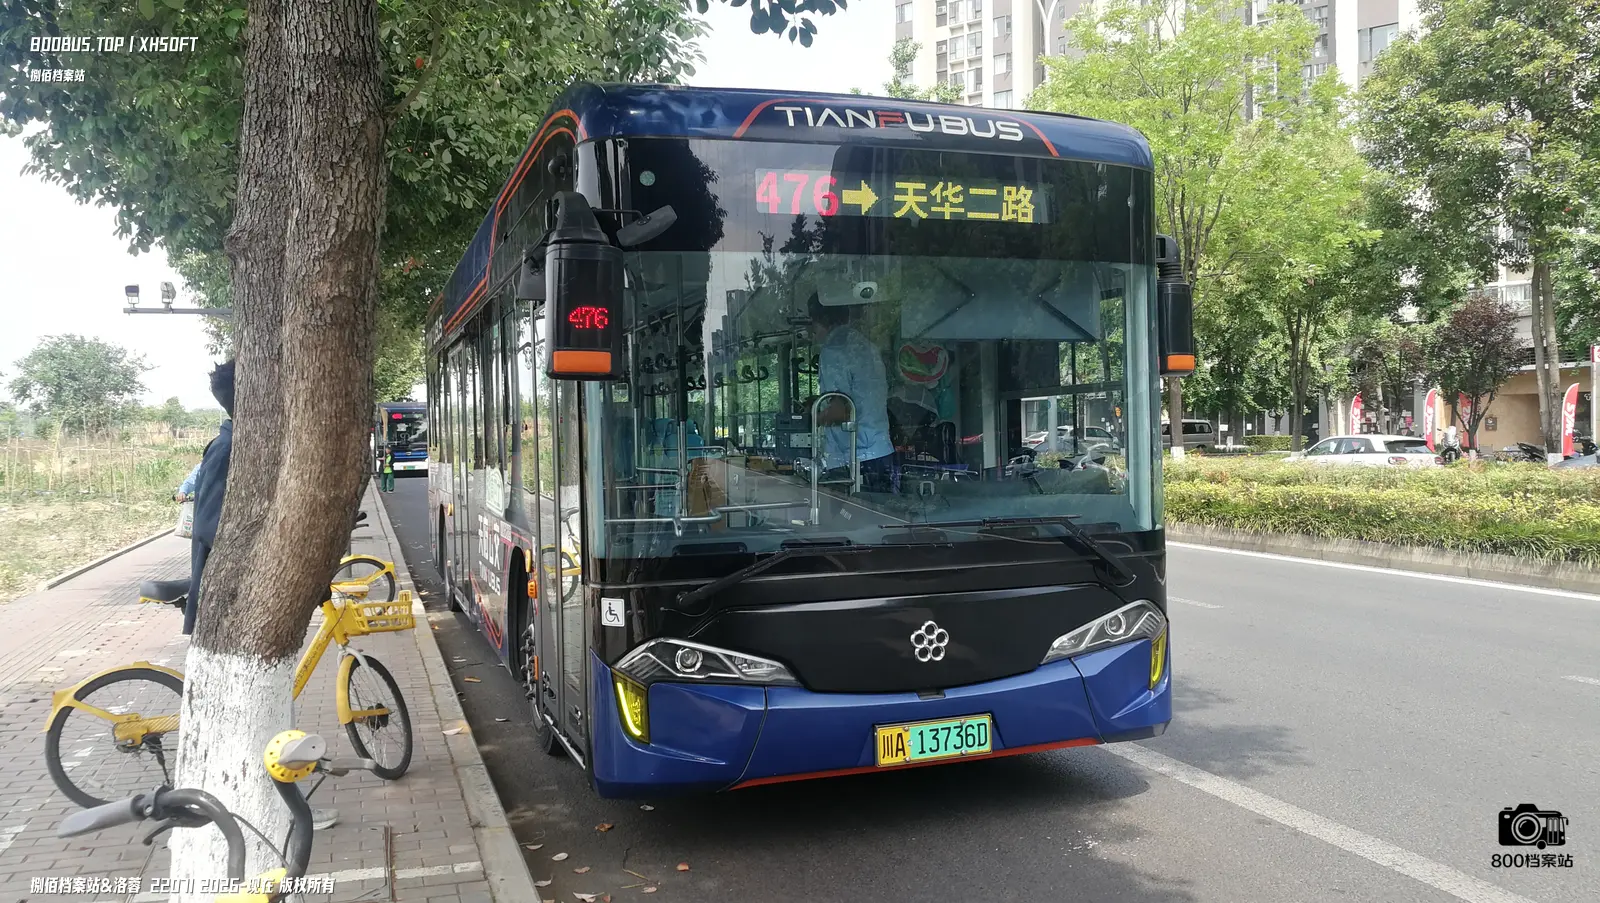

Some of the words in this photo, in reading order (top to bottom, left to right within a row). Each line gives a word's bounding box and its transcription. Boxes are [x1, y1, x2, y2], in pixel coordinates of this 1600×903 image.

[755, 171, 839, 217] 476
[893, 181, 1034, 223] 天华二路
[568, 306, 608, 329] 476
[1565, 402, 1575, 436] SYM
[882, 732, 906, 759] 川A
[918, 722, 988, 755] 13736D
